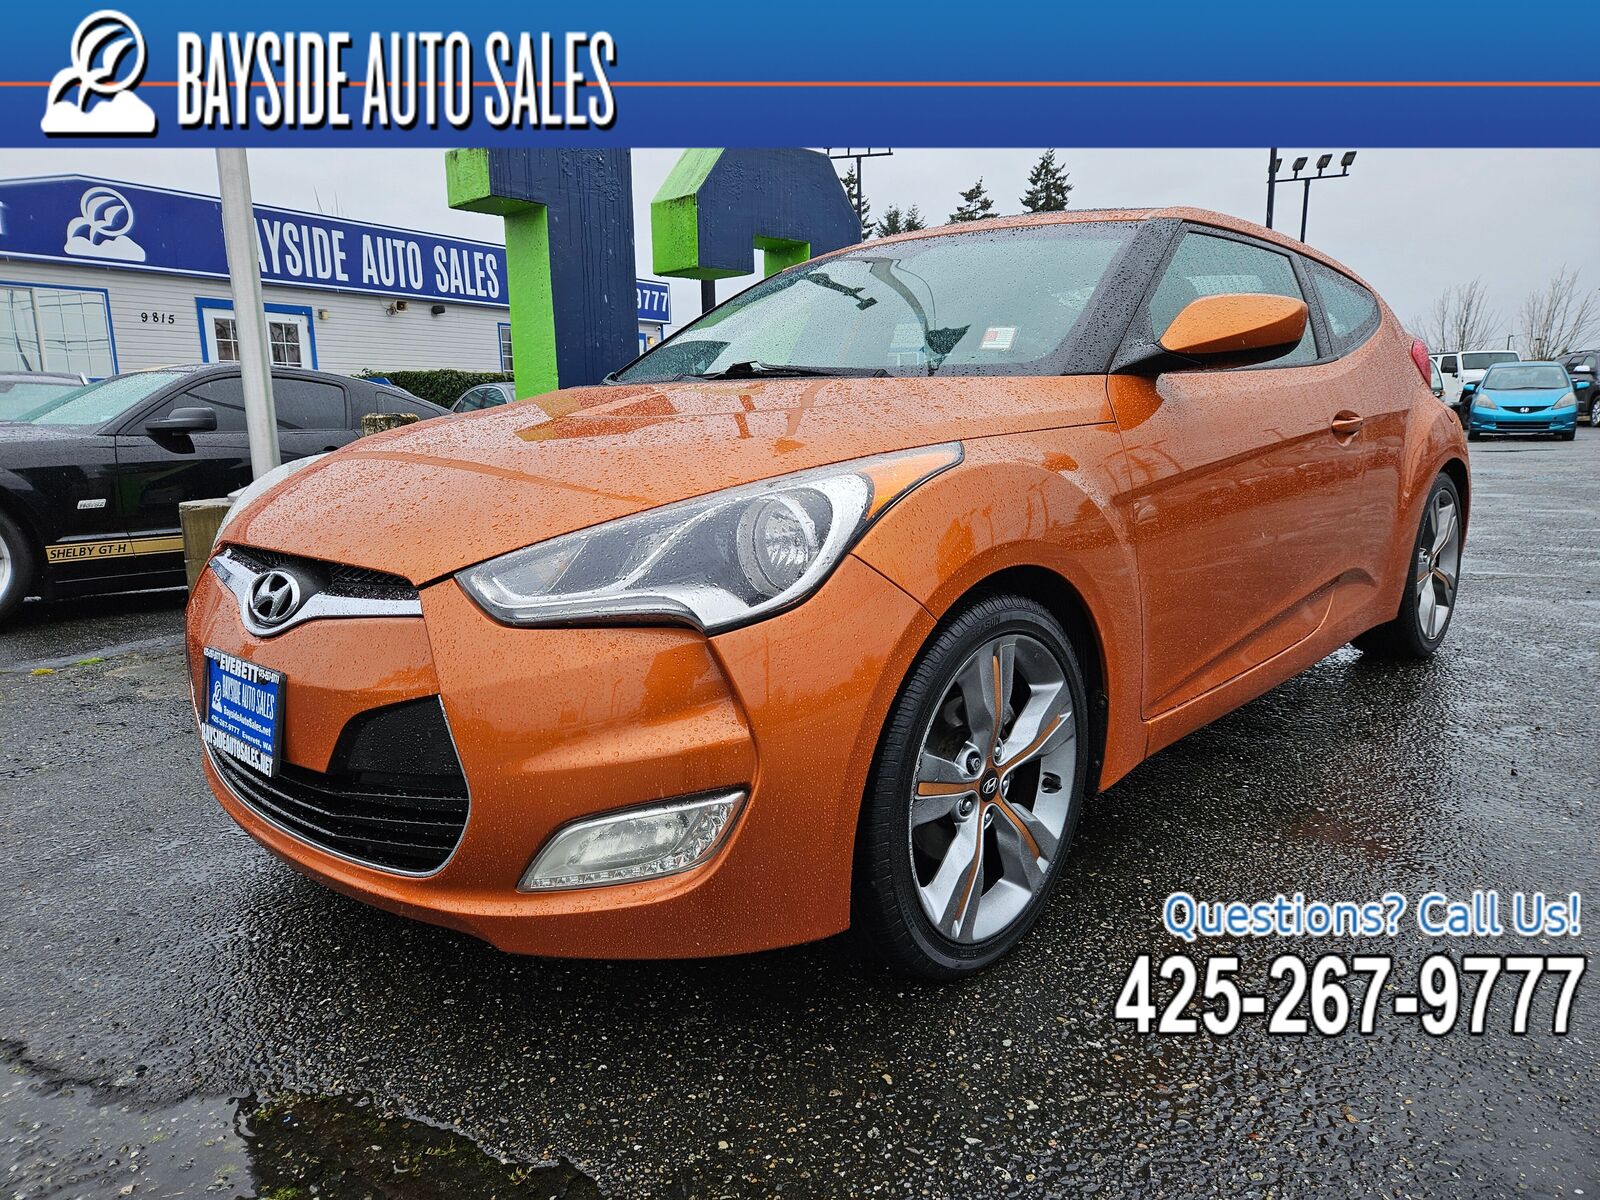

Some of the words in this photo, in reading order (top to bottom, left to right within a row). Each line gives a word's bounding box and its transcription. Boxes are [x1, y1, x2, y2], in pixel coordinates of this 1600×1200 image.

[222, 212, 350, 282] AYSIDE
[362, 234, 424, 290] AUTO
[433, 245, 500, 299] SALES
[140, 311, 175, 325] 9815
[50, 547, 94, 559] SHELBY
[98, 544, 126, 555] GT-H
[219, 653, 260, 684] EVERETT
[241, 683, 256, 712] AUTO
[256, 689, 275, 720] SALES
[201, 722, 274, 778] BAYSIDEAUTOSALES.NET
[210, 714, 240, 735] 425-267-9777
[241, 730, 262, 749] Everett,
[262, 741, 273, 752] WA
